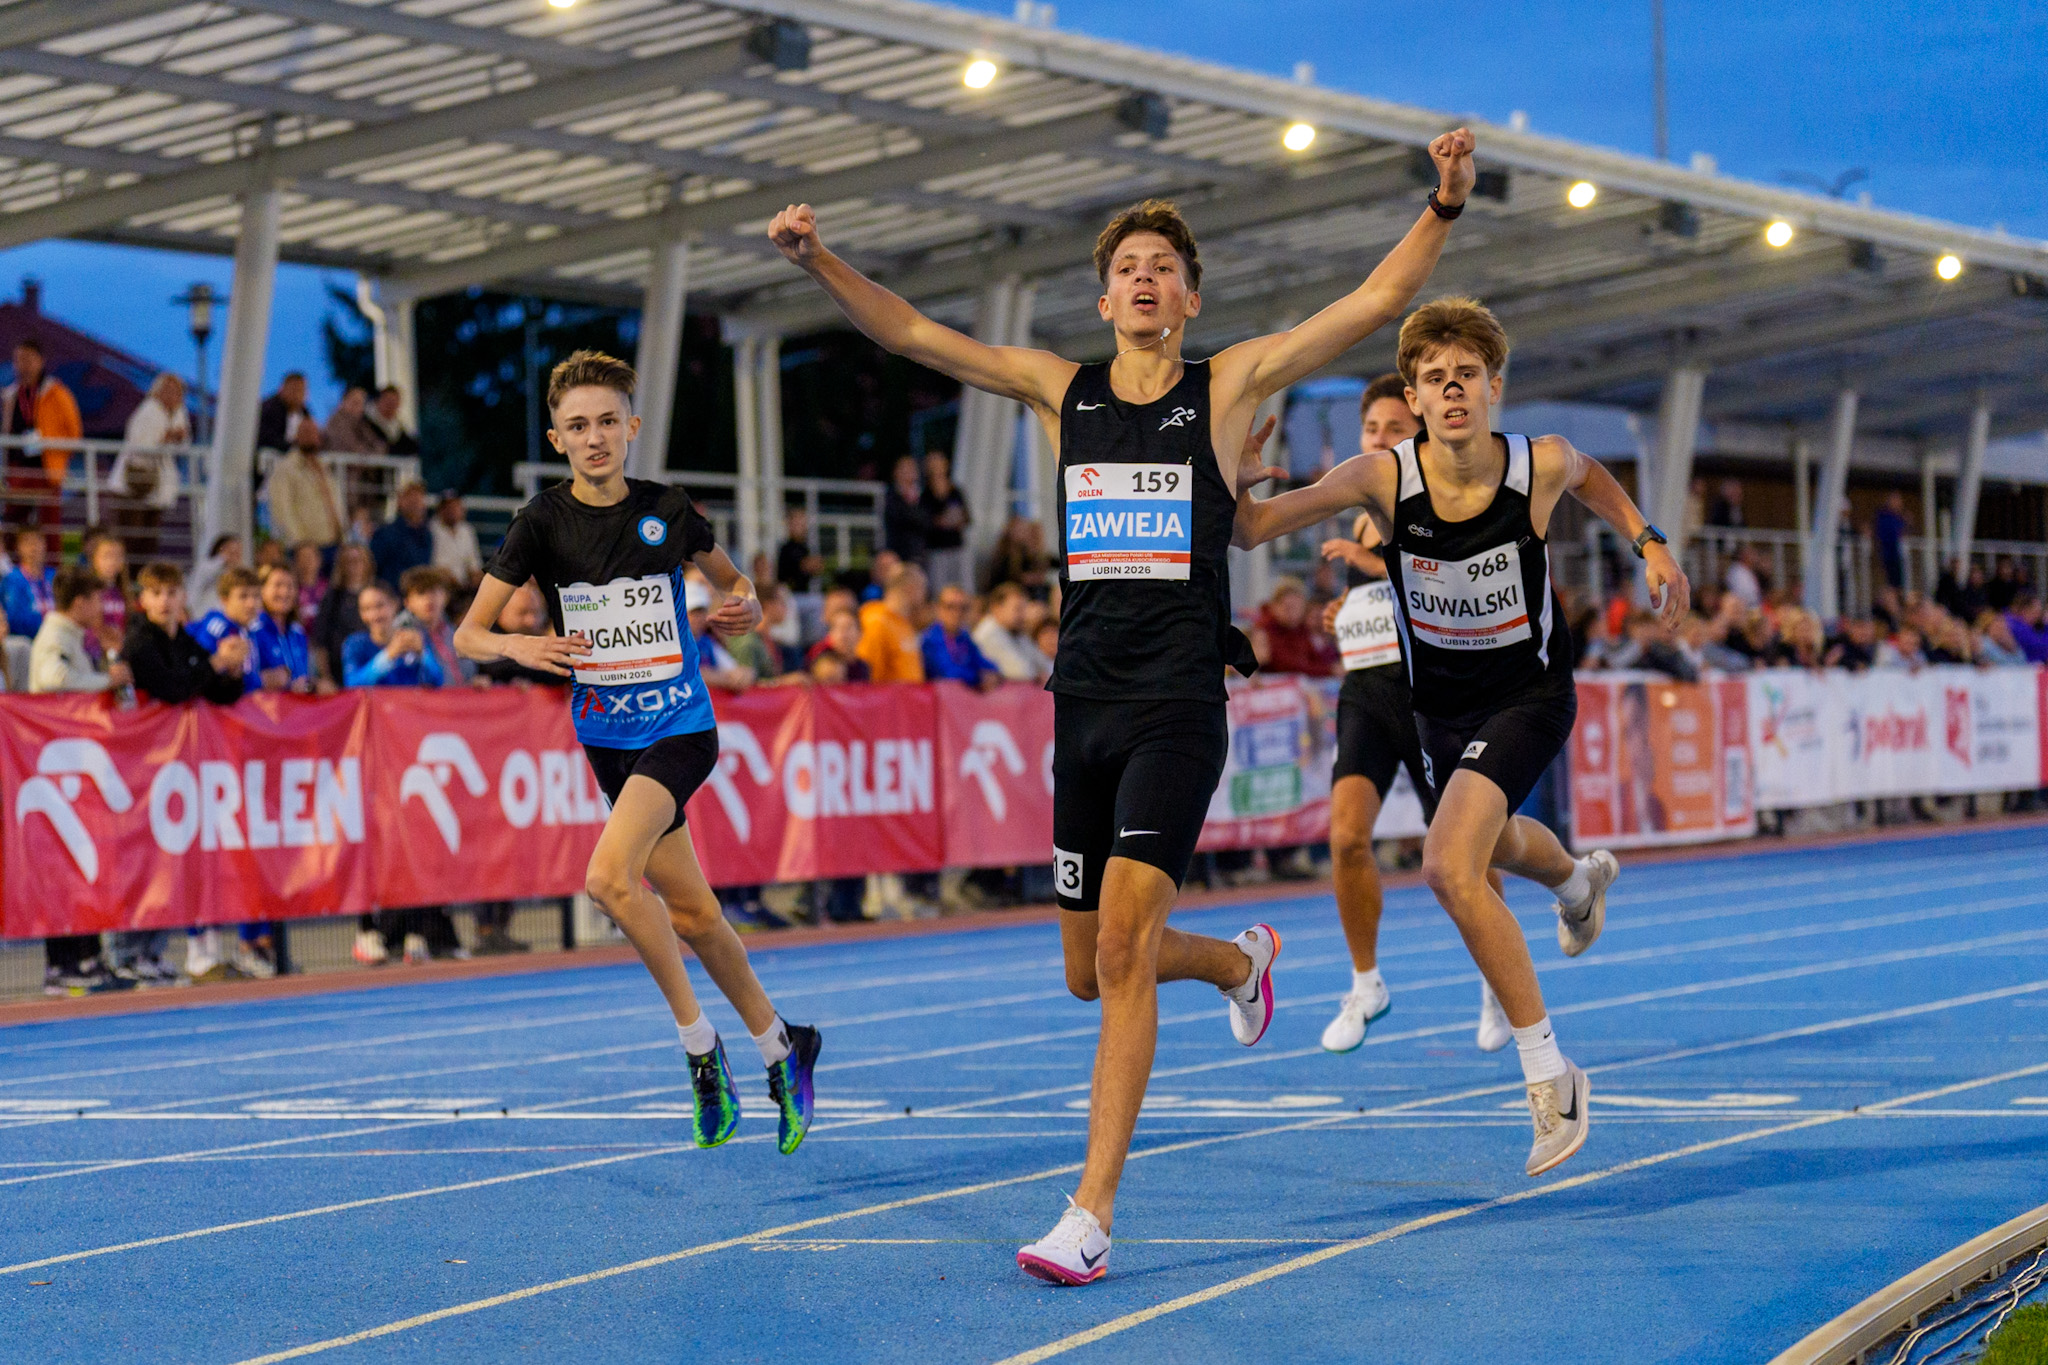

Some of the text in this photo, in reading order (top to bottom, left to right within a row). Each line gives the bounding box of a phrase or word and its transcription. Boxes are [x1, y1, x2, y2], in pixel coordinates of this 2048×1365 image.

[1132, 471, 1180, 493] 159
[1078, 489, 1103, 498] ORLEN
[1070, 512, 1185, 539] ZAWIEJA
[1092, 565, 1151, 575] LUBIN 2026
[1412, 558, 1439, 572] RCU
[1467, 553, 1508, 583] 968
[562, 594, 591, 603] GRUPA
[564, 602, 599, 612] LUXMED
[624, 585, 663, 608] 592
[1410, 584, 1518, 618] SUWALSKI
[1441, 637, 1498, 646] LUBIN 2026
[600, 670, 652, 682] LUBIN 2026
[580, 682, 693, 719] AXON
[500, 749, 612, 829] ORL
[783, 738, 935, 820] ORLEN
[150, 756, 366, 856] ORLEN
